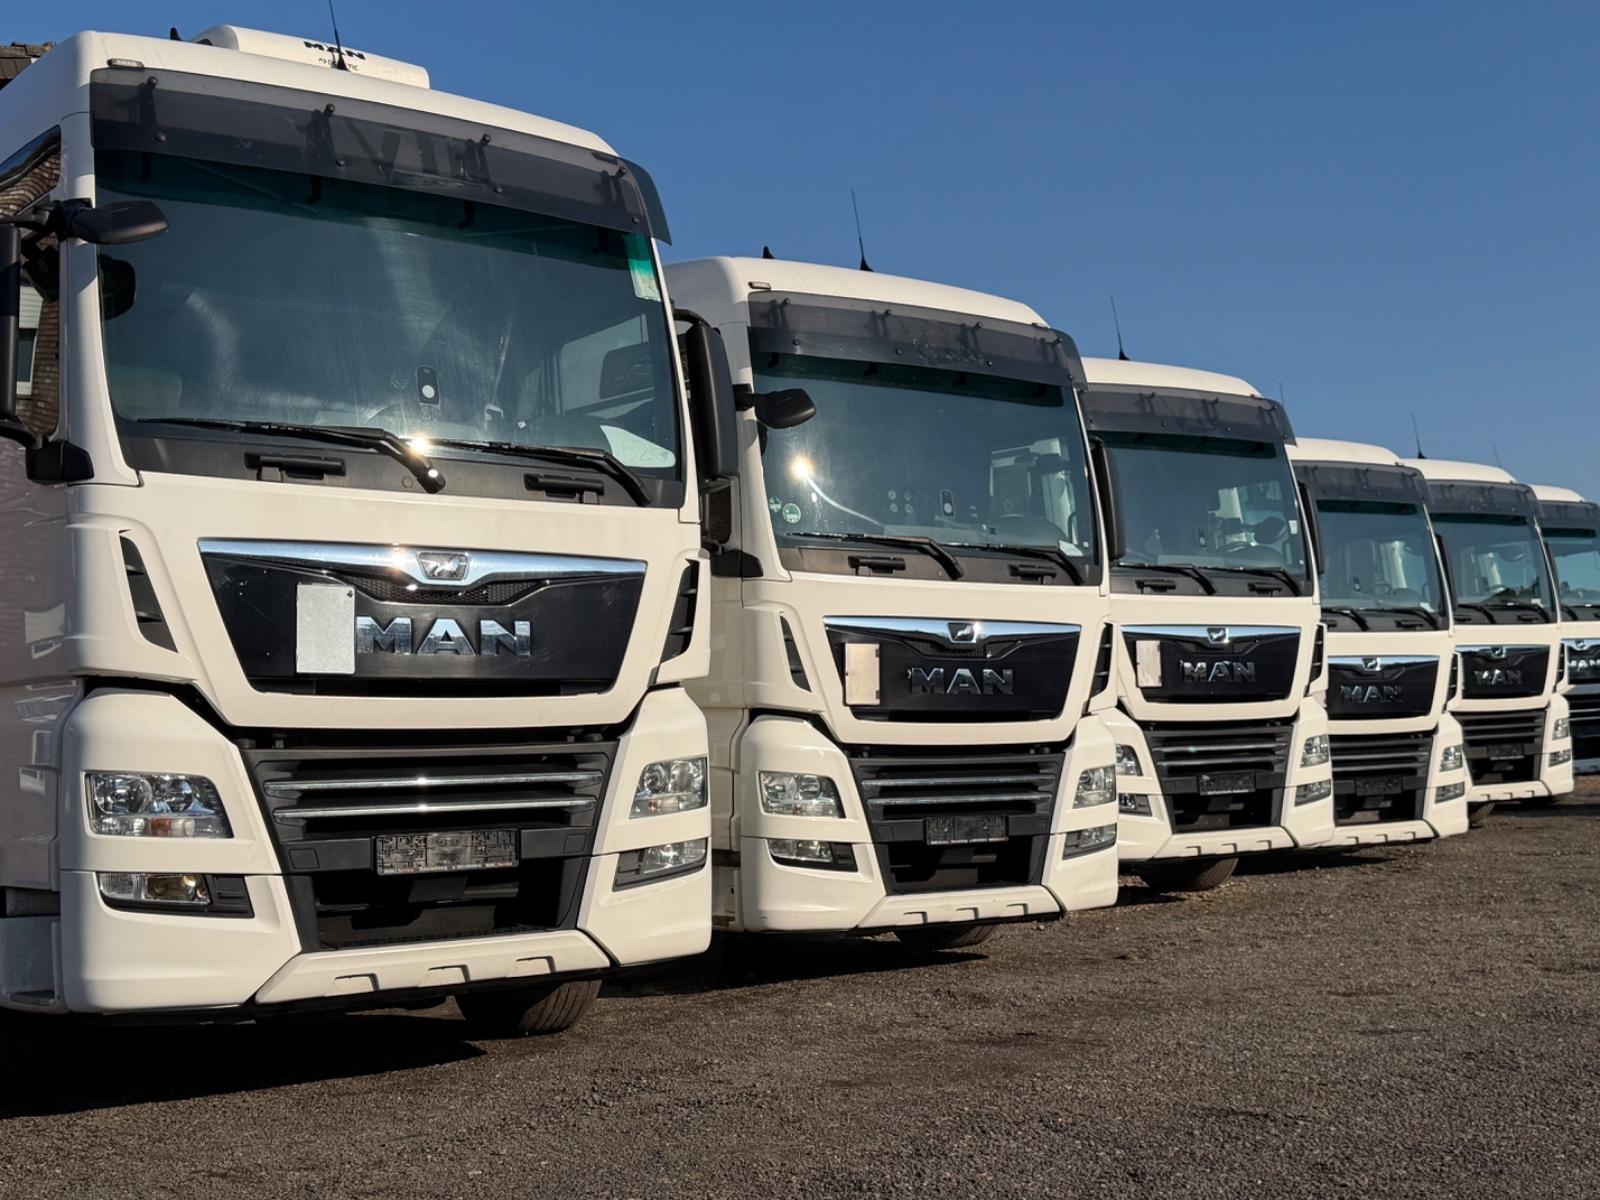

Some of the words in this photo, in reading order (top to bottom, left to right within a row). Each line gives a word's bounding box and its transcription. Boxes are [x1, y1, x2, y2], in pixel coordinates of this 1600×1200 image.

[304, 41, 366, 60] MAN
[356, 615, 531, 656] MAN
[911, 667, 1014, 695] MAN
[1182, 661, 1256, 682] MAN
[1474, 669, 1523, 685] MAN
[1341, 685, 1403, 703] MAN
